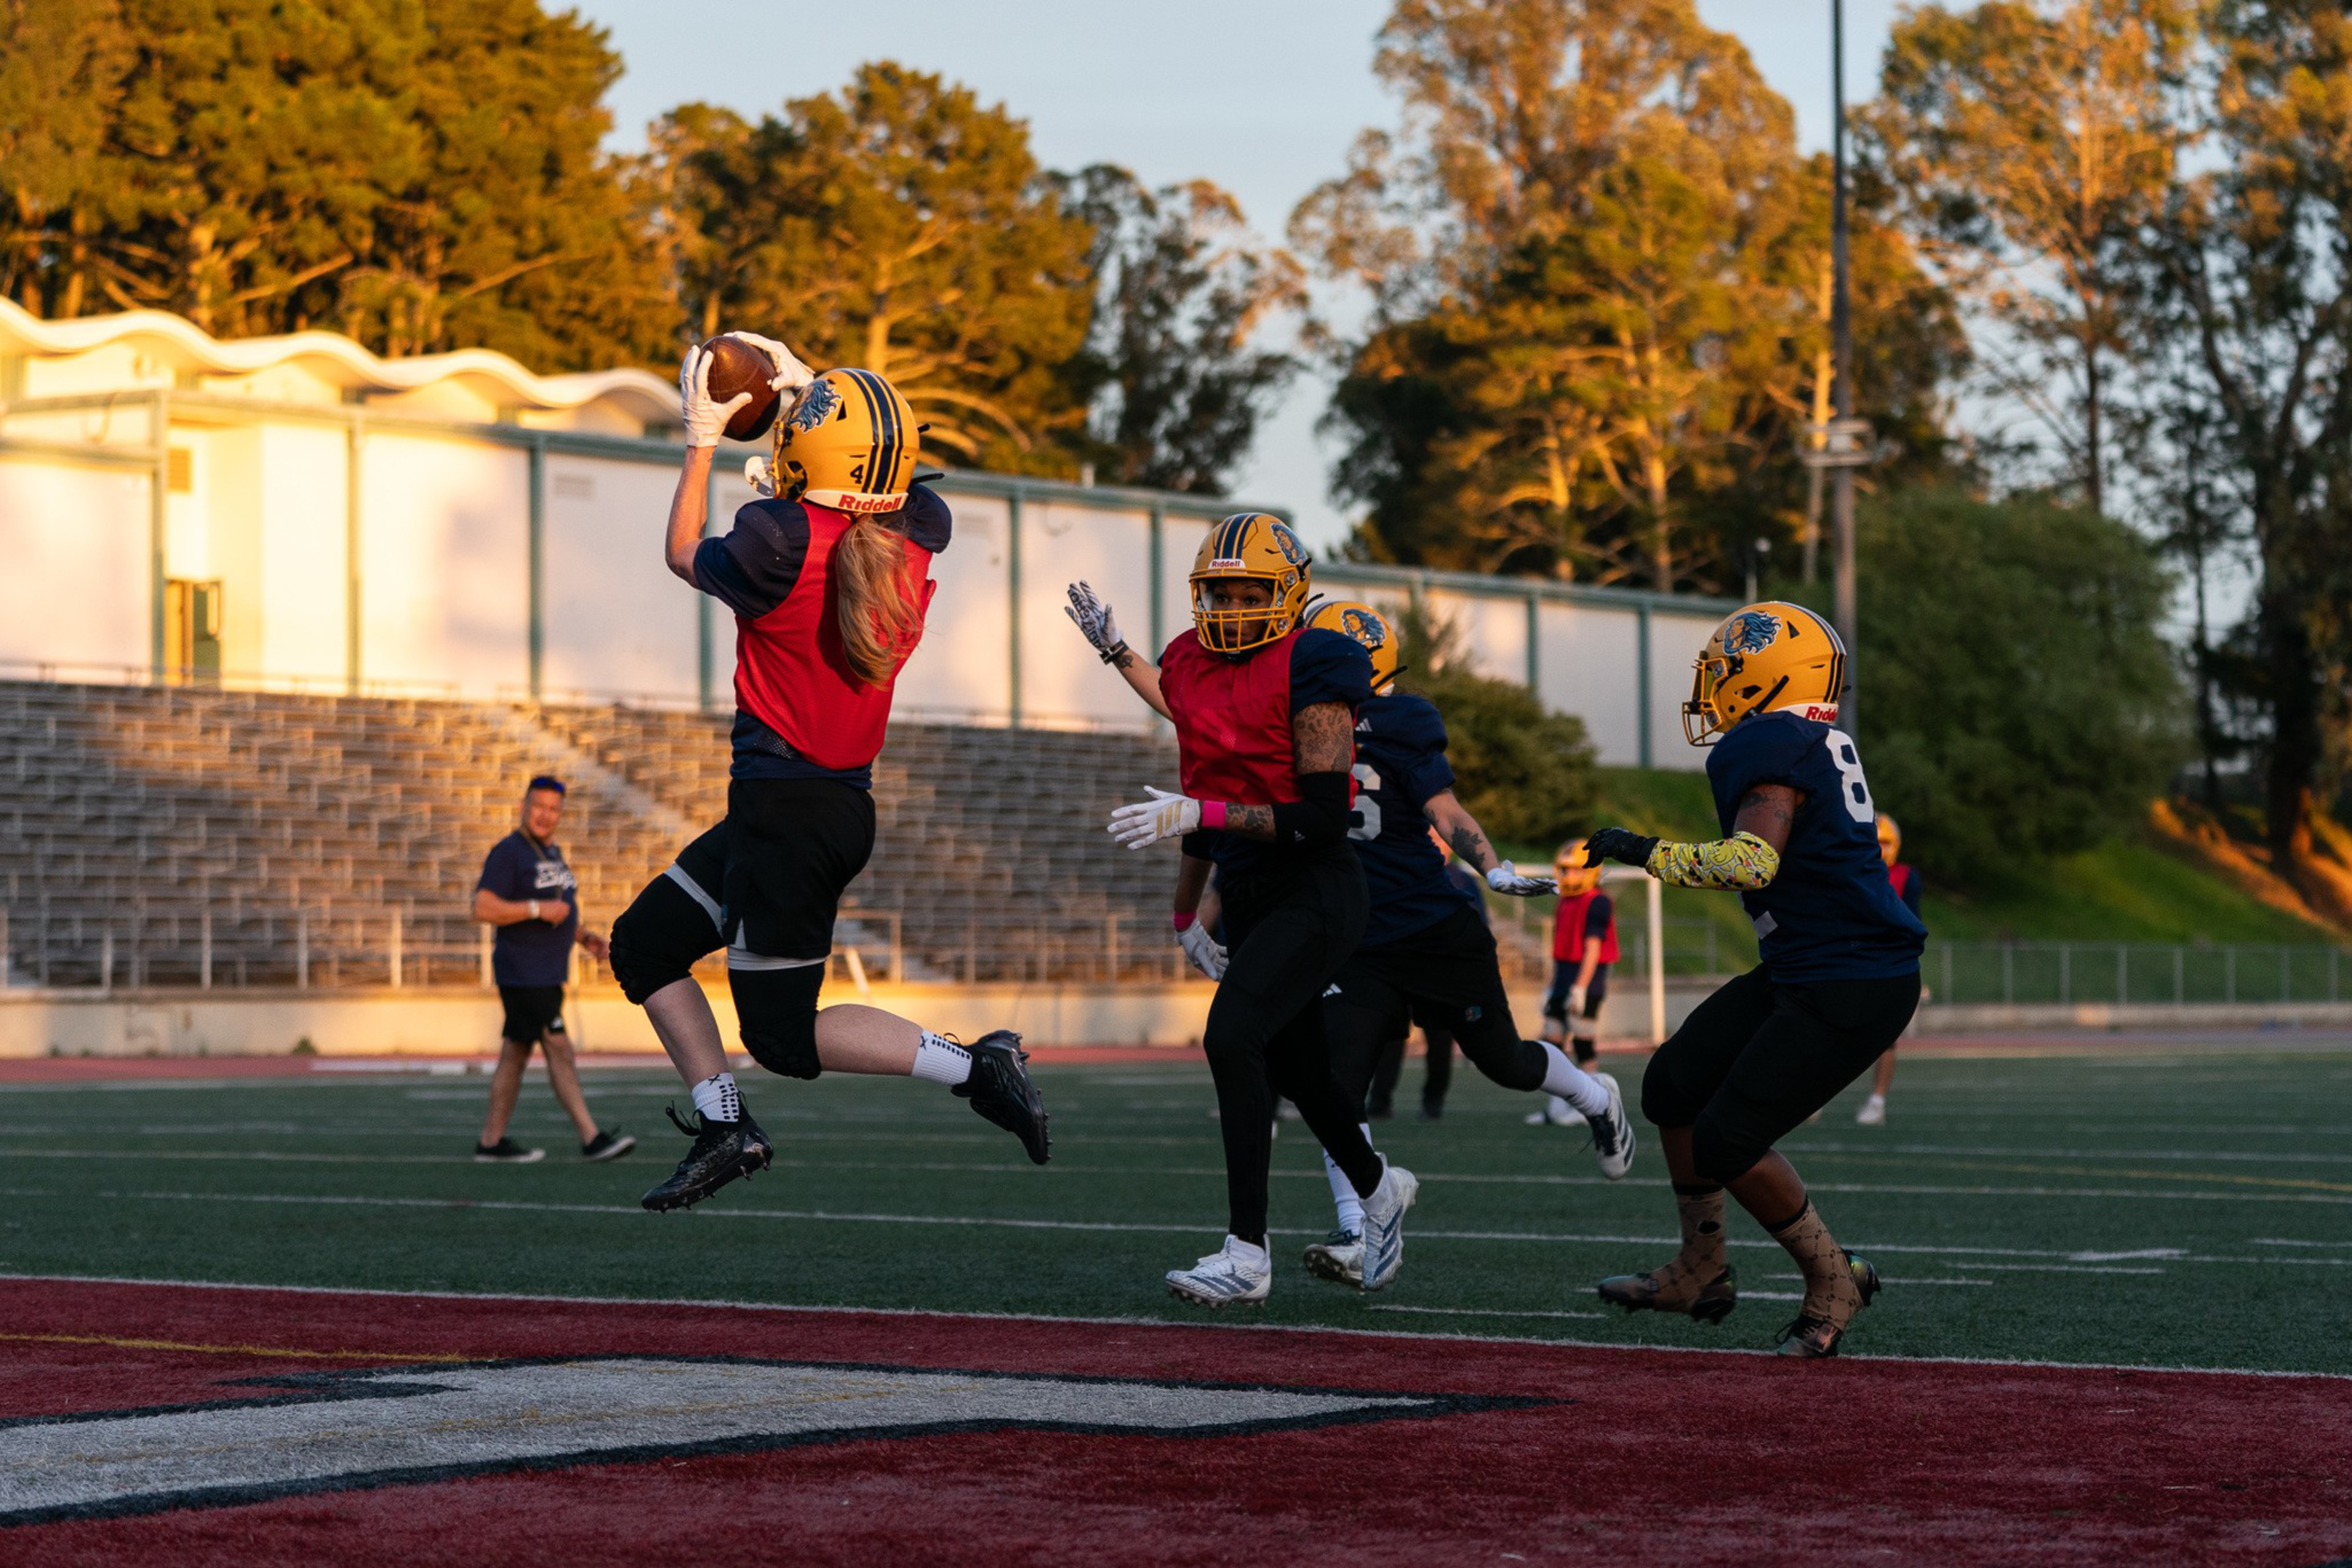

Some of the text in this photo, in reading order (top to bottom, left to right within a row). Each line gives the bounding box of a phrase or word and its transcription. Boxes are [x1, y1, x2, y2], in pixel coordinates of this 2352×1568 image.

[850, 464, 864, 484] 4
[838, 494, 902, 511] Riddell
[1825, 728, 1875, 823] 8
